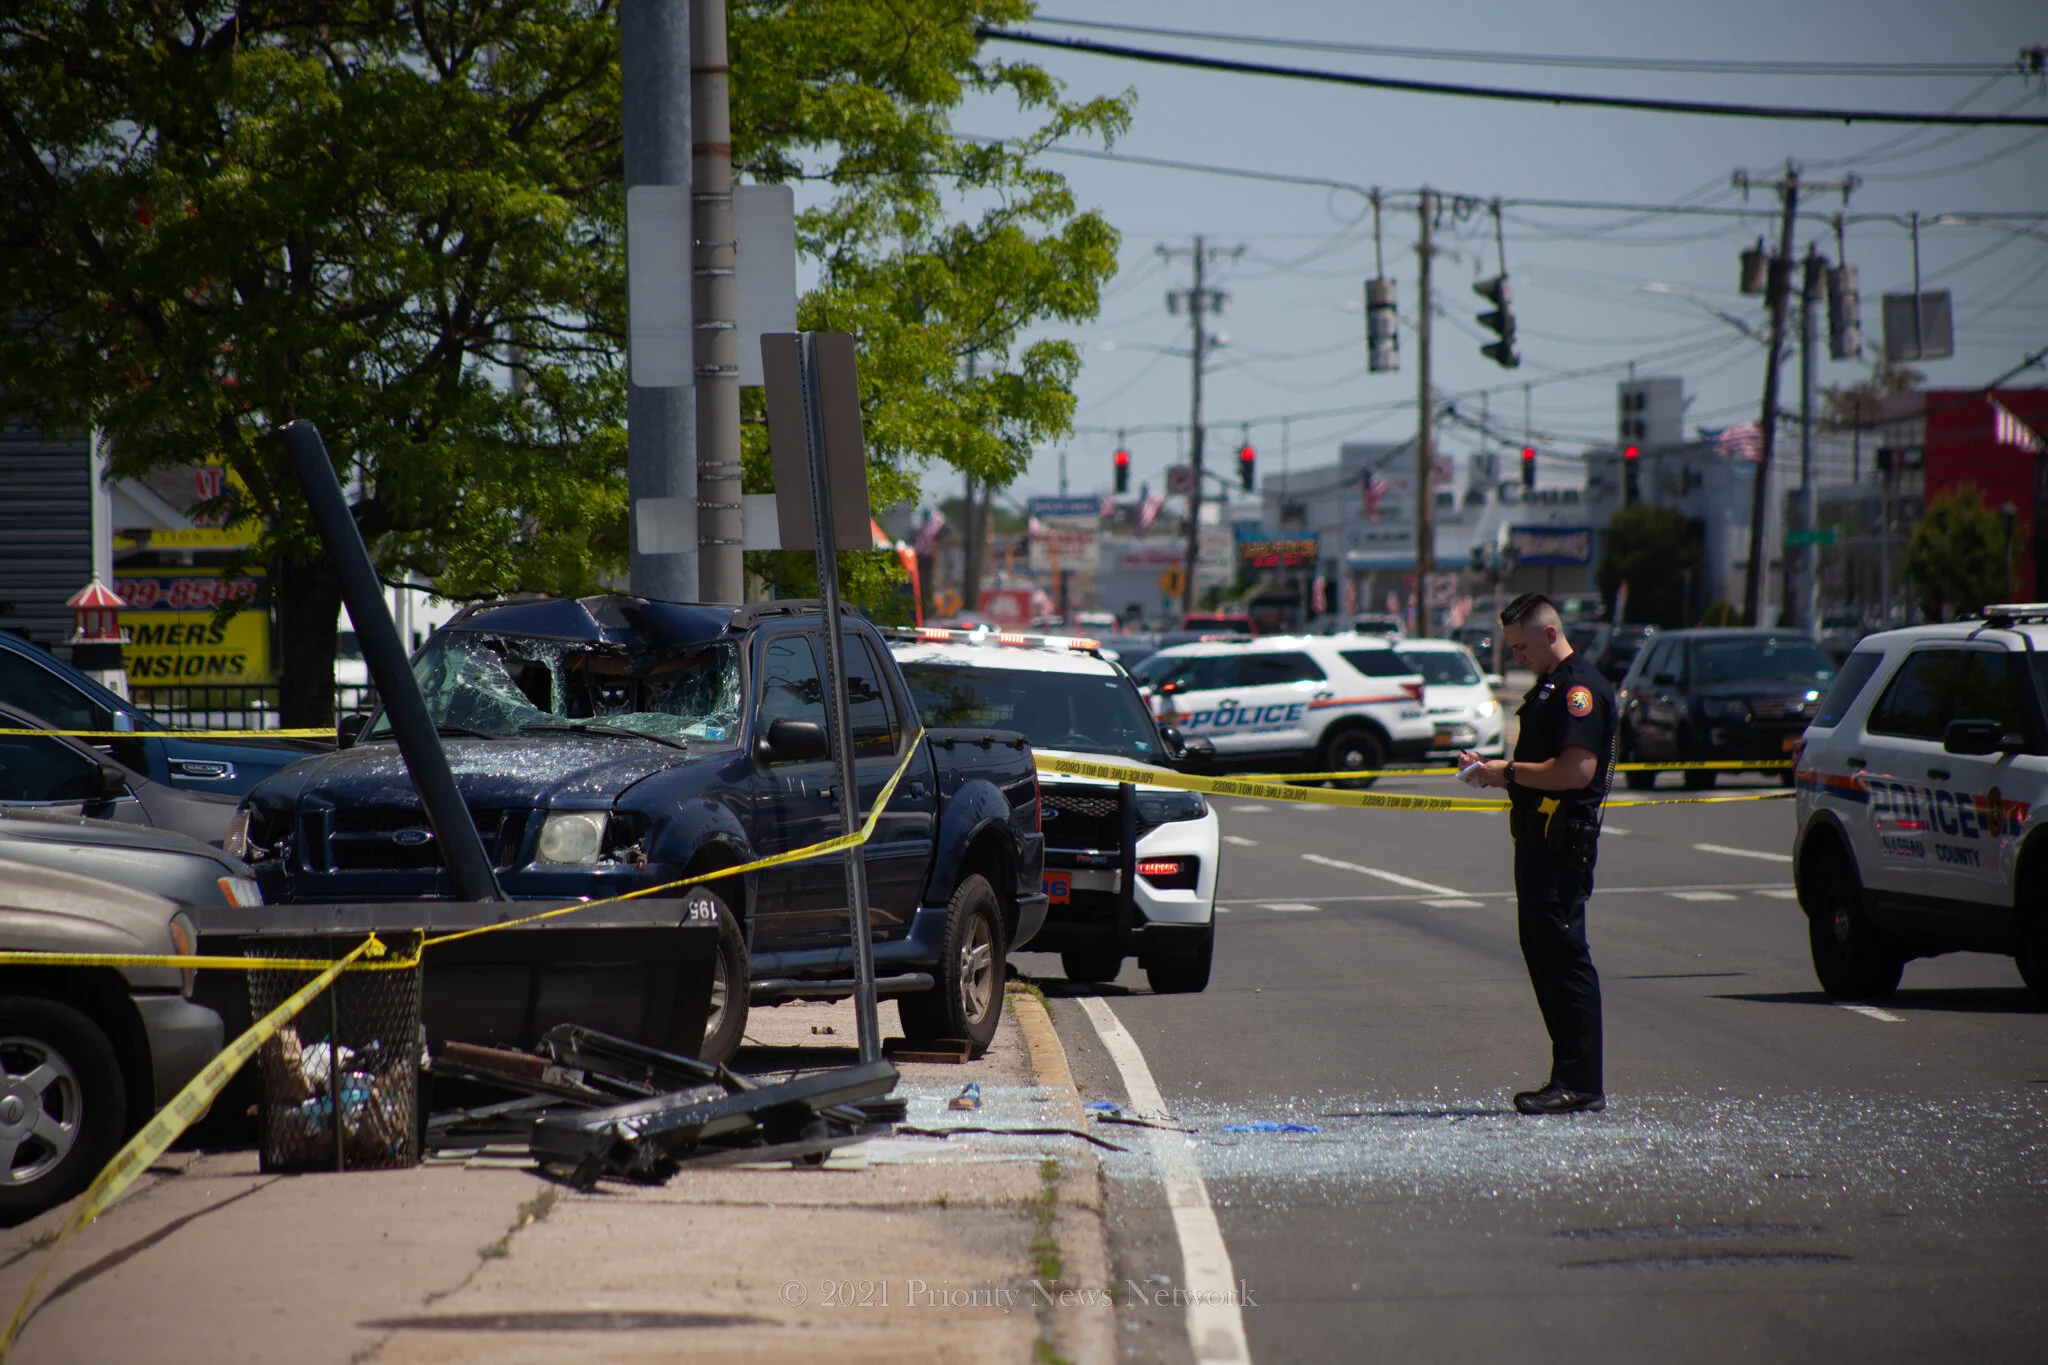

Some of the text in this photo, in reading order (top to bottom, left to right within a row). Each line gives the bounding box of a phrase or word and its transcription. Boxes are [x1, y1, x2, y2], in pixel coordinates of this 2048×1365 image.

[1189, 702, 1307, 729] POLICE
[1868, 780, 1981, 839] POLICE
[1935, 842, 1980, 868] COUNTY
[688, 900, 718, 921] 195
